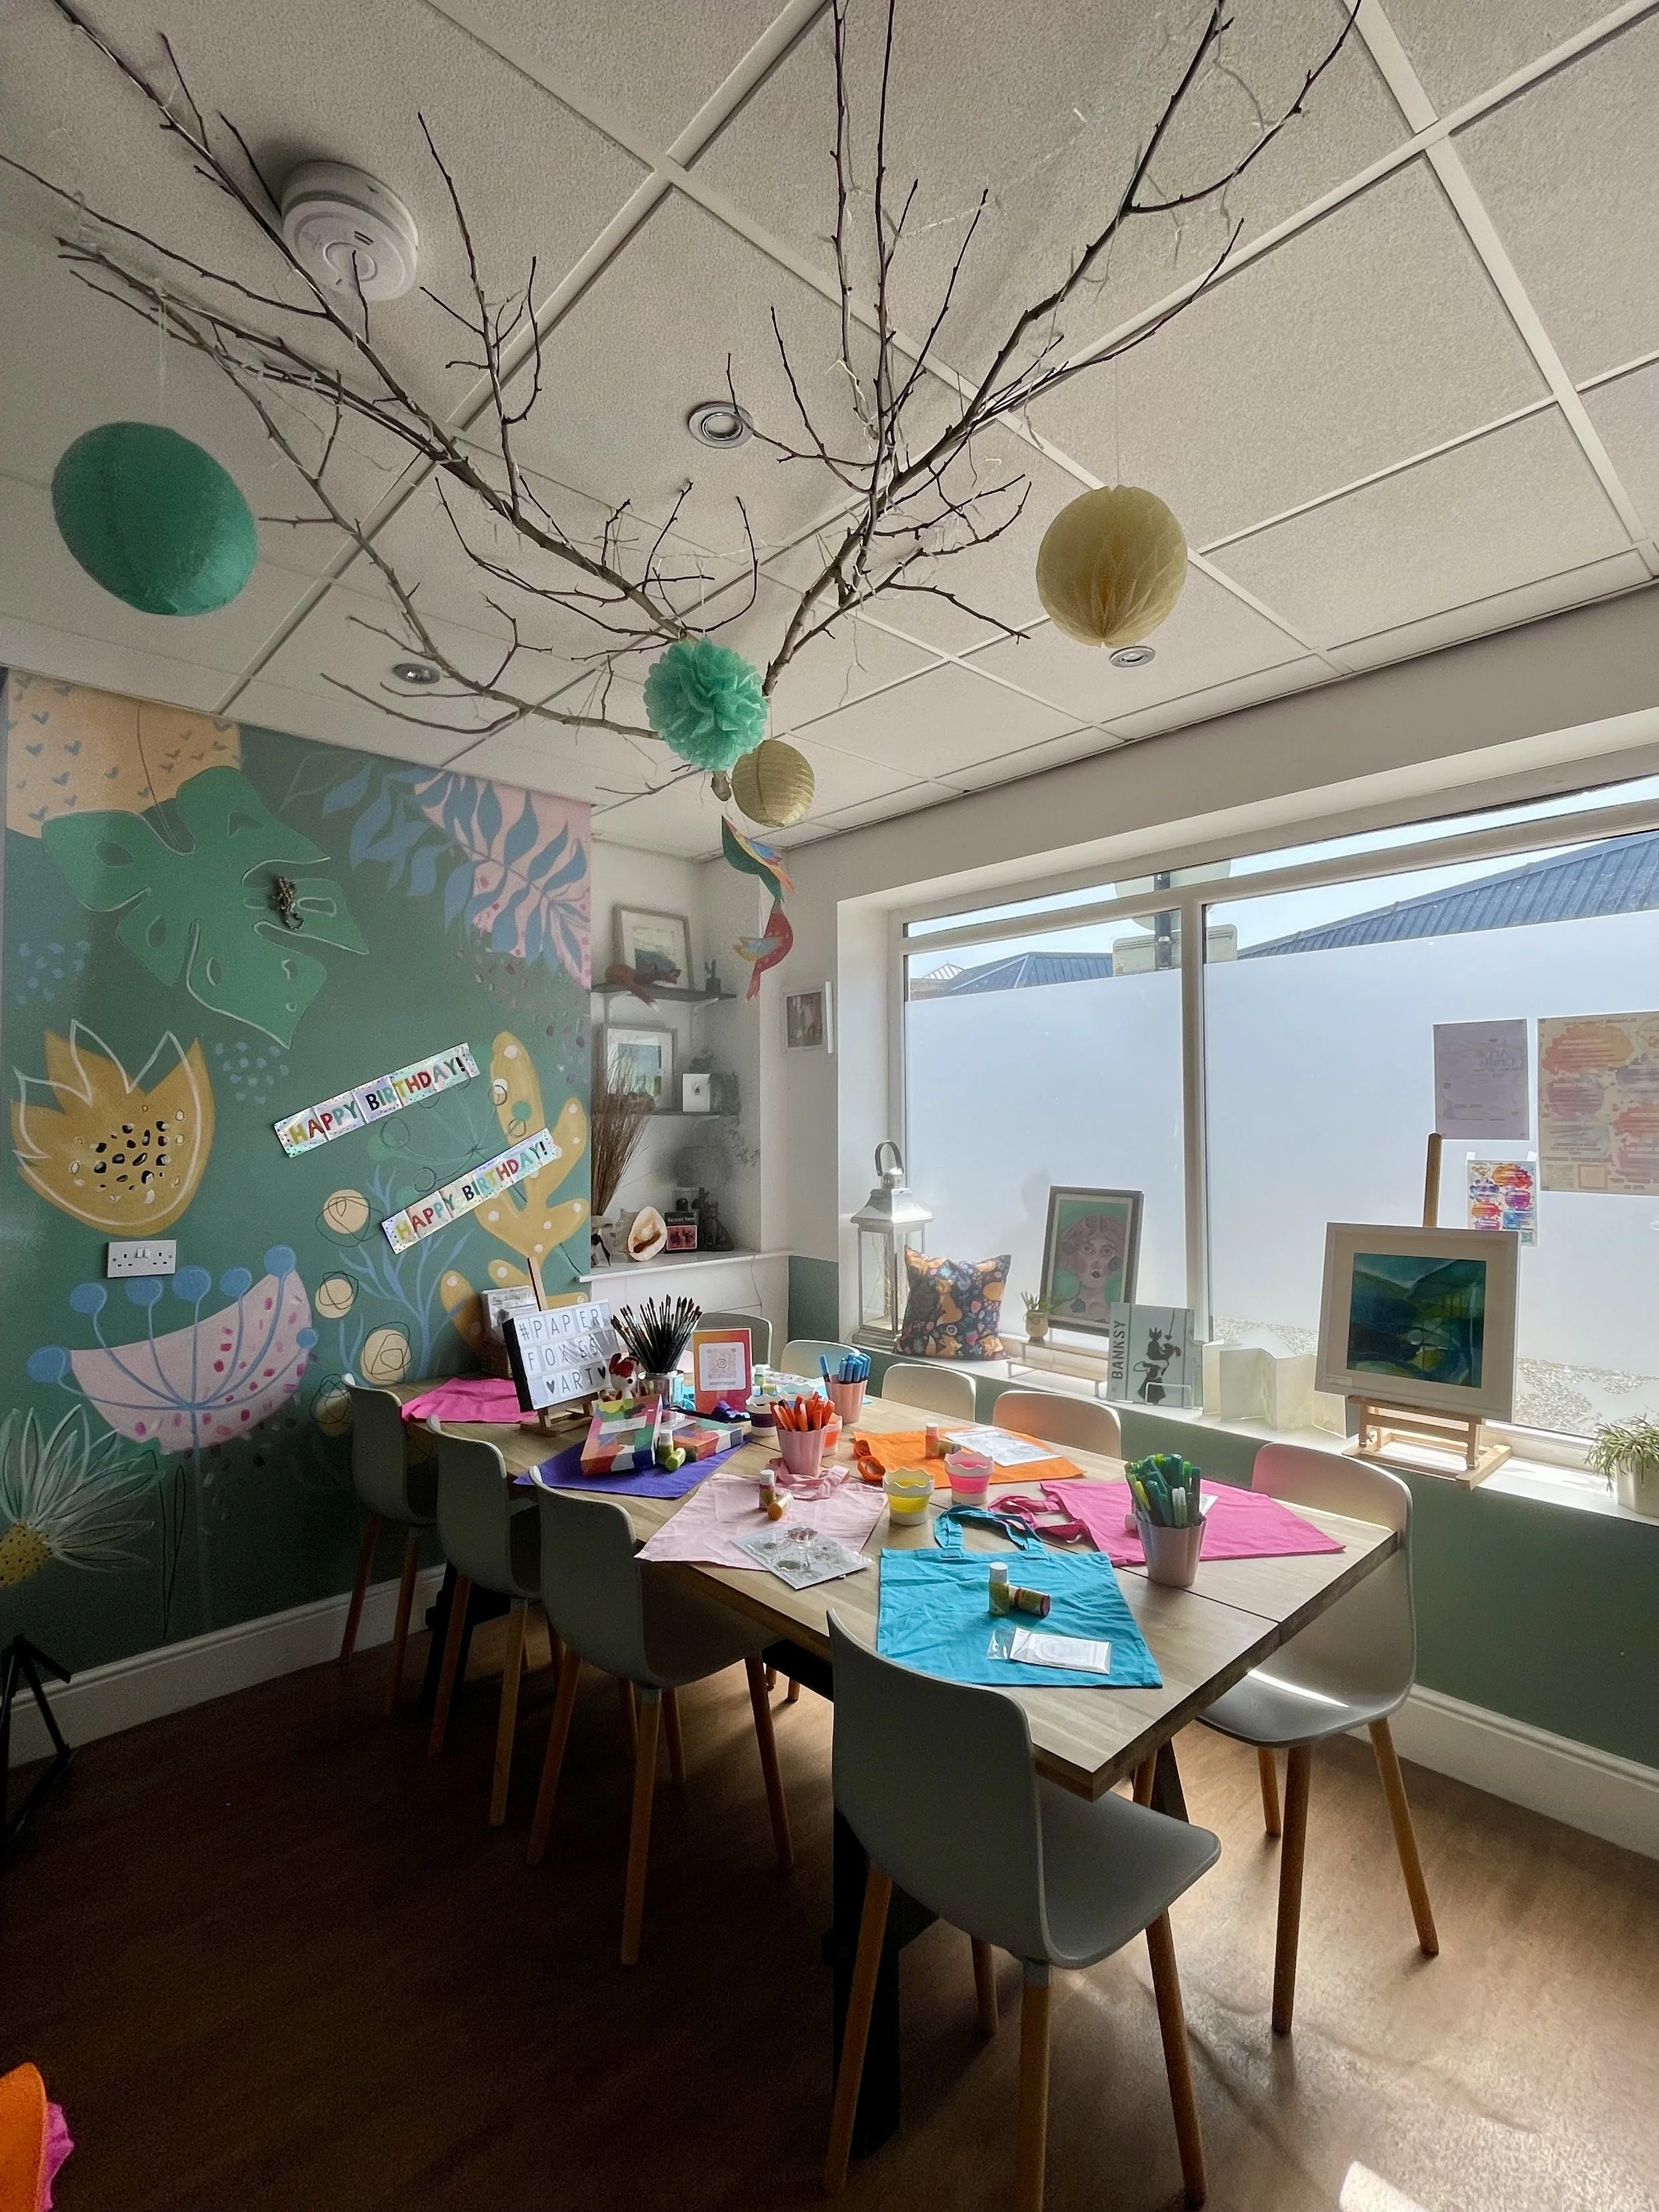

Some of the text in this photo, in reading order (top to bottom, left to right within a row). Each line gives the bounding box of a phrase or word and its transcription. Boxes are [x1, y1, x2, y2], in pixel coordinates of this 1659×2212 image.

[289, 1056, 466, 1144] HAPPY BIRTHDAY!
[395, 1141, 549, 1240] HAPPY BIRTHDAY!
[519, 1309, 600, 1341] #PAPER
[528, 1337, 598, 1371] FOXES
[1112, 1321, 1125, 1379] BANKSY
[562, 1368, 593, 1391] ART
